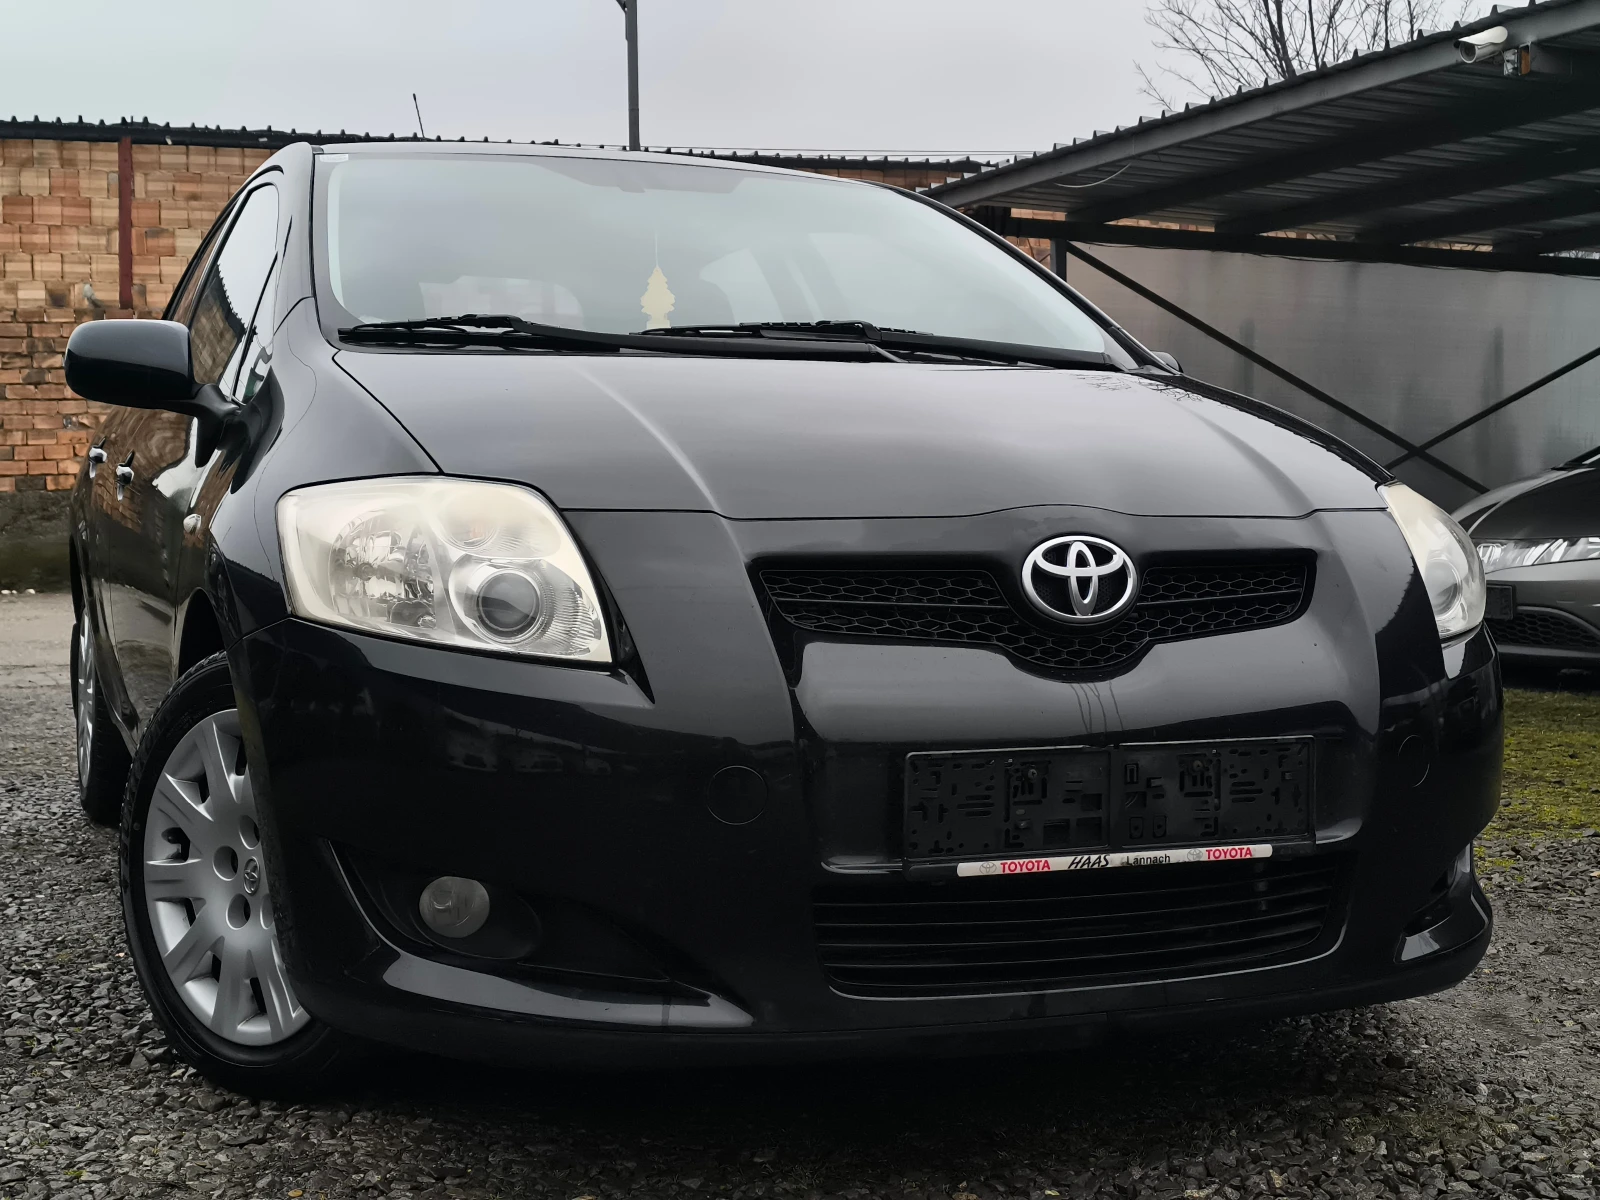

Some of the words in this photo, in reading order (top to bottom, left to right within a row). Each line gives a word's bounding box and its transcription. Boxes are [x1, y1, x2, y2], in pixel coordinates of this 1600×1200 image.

[1000, 860, 1050, 873] TOYOTA
[1067, 854, 1110, 869] HAAS
[1126, 854, 1171, 866] Lannach
[1206, 847, 1253, 861] TOYOTA
